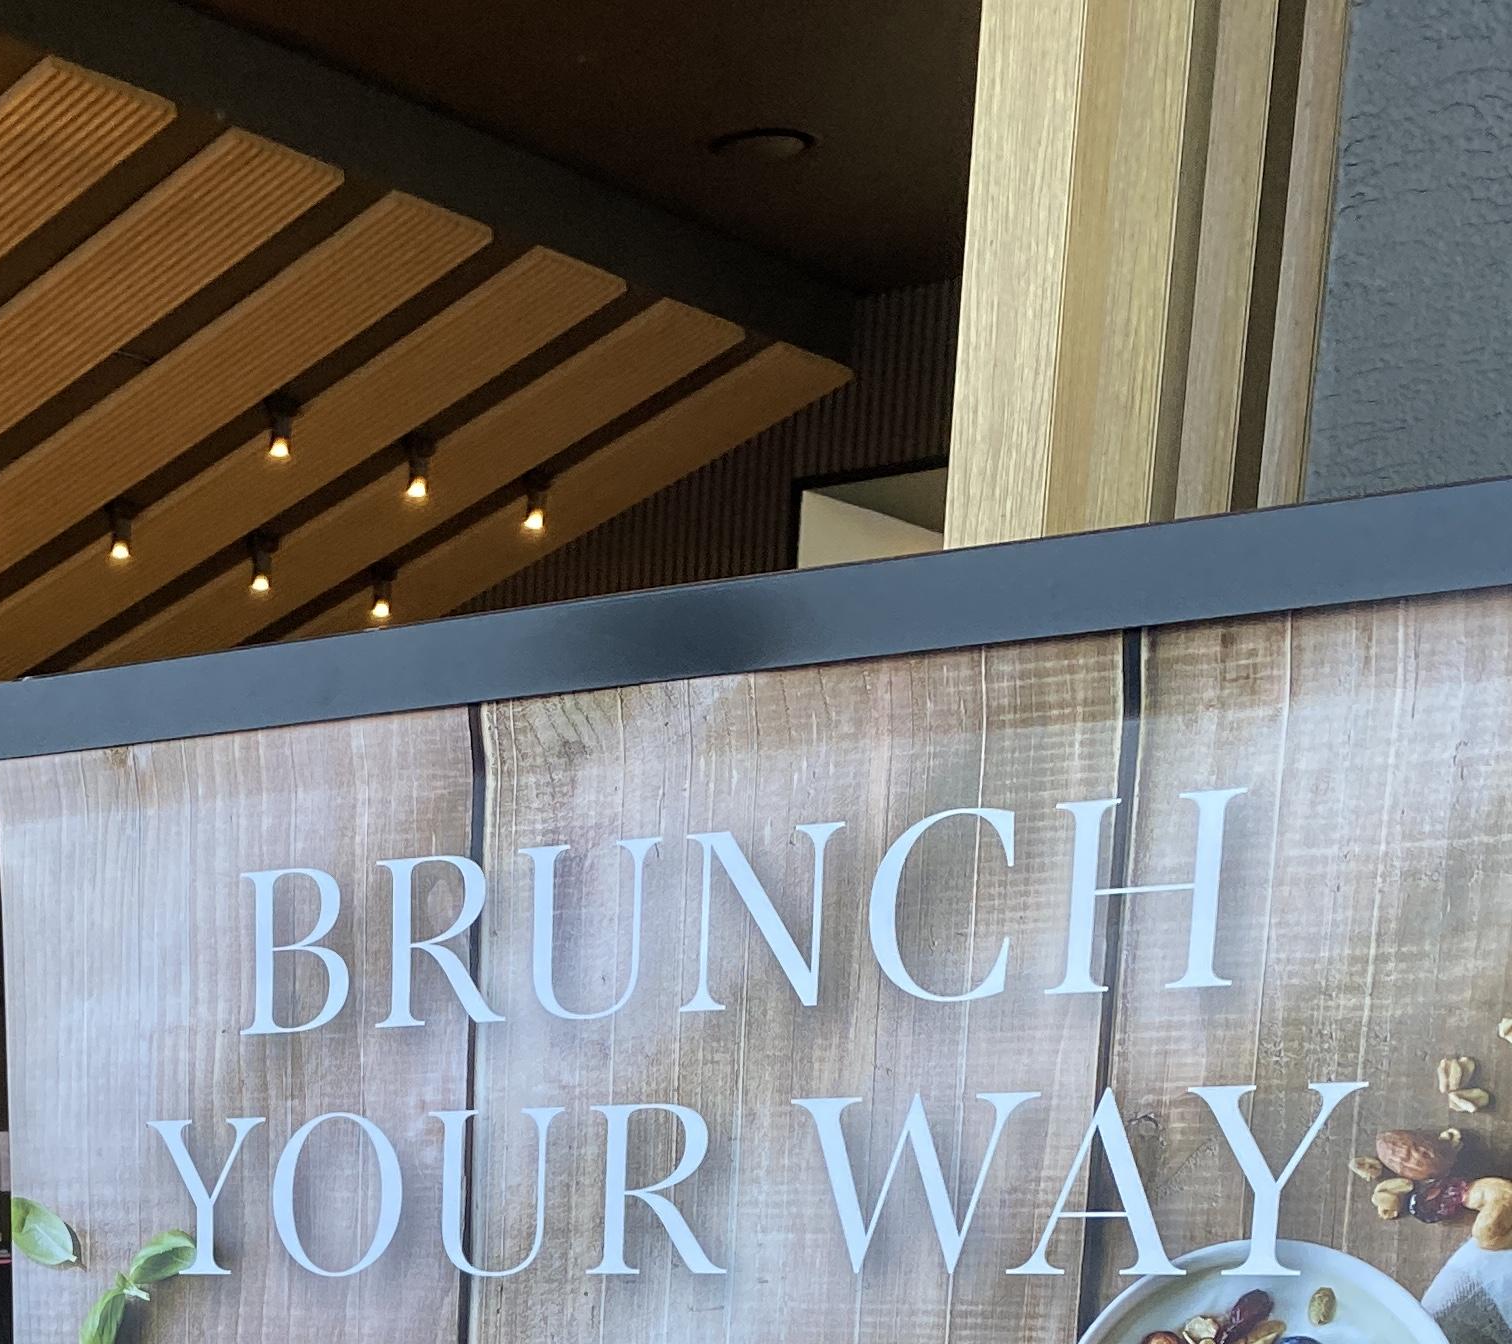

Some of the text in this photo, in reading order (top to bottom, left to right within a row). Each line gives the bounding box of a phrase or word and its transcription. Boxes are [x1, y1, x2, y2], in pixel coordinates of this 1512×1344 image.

[238, 787, 1247, 1037] BRUNCH
[150, 1081, 1370, 1277] YOUR WAY
